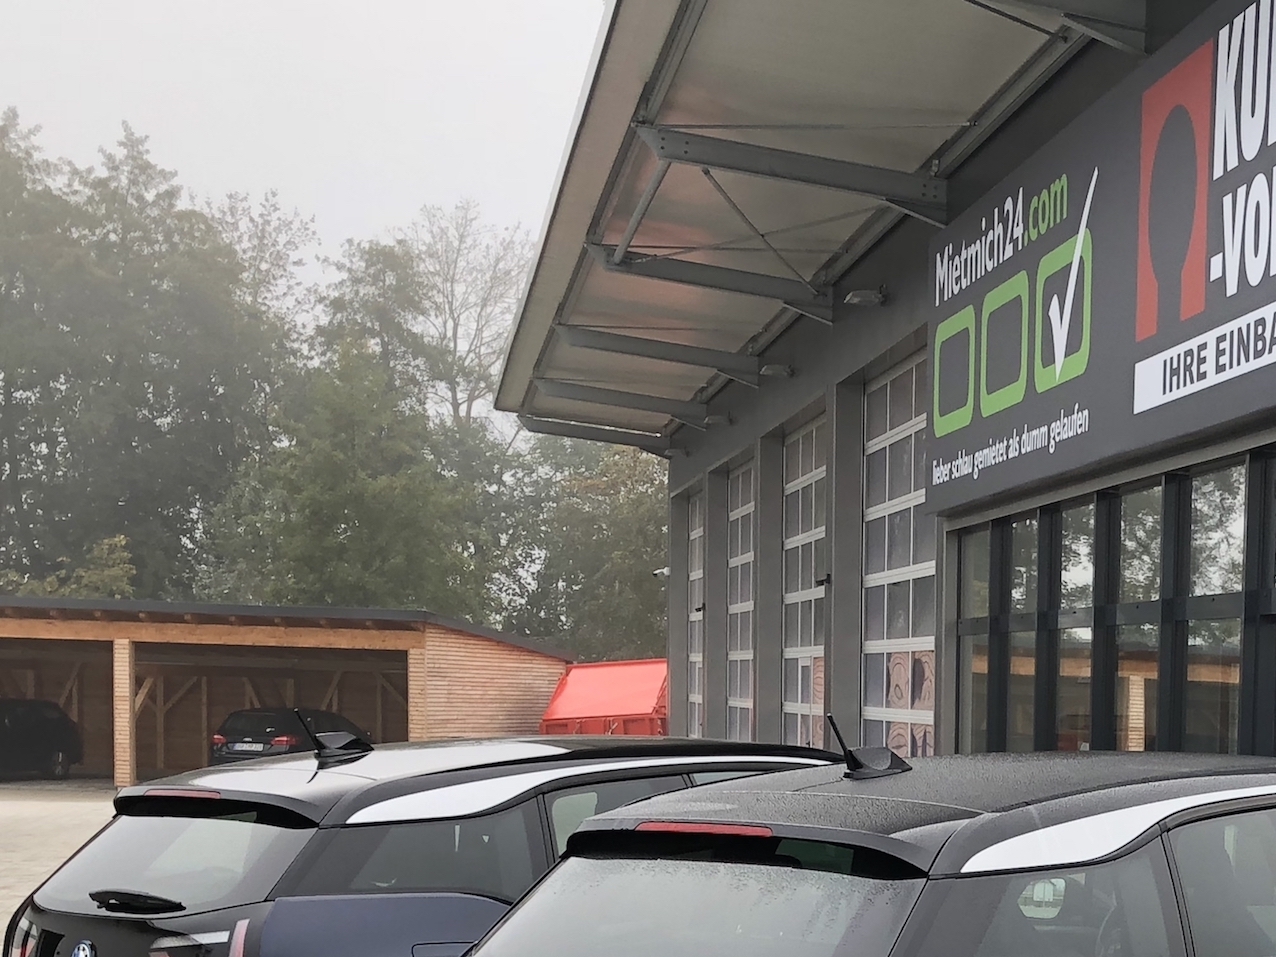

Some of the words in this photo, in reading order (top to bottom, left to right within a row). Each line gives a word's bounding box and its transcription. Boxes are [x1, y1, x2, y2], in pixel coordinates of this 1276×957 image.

[935, 173, 1068, 307] Mietmich24.com
[1161, 341, 1208, 396] IHRE
[932, 458, 951, 485] lieber
[951, 448, 974, 479] schlau
[973, 436, 1007, 480] gemietet
[1008, 428, 1020, 459] als
[1020, 423, 1048, 454] dumm
[1049, 402, 1089, 454] gelaufen
